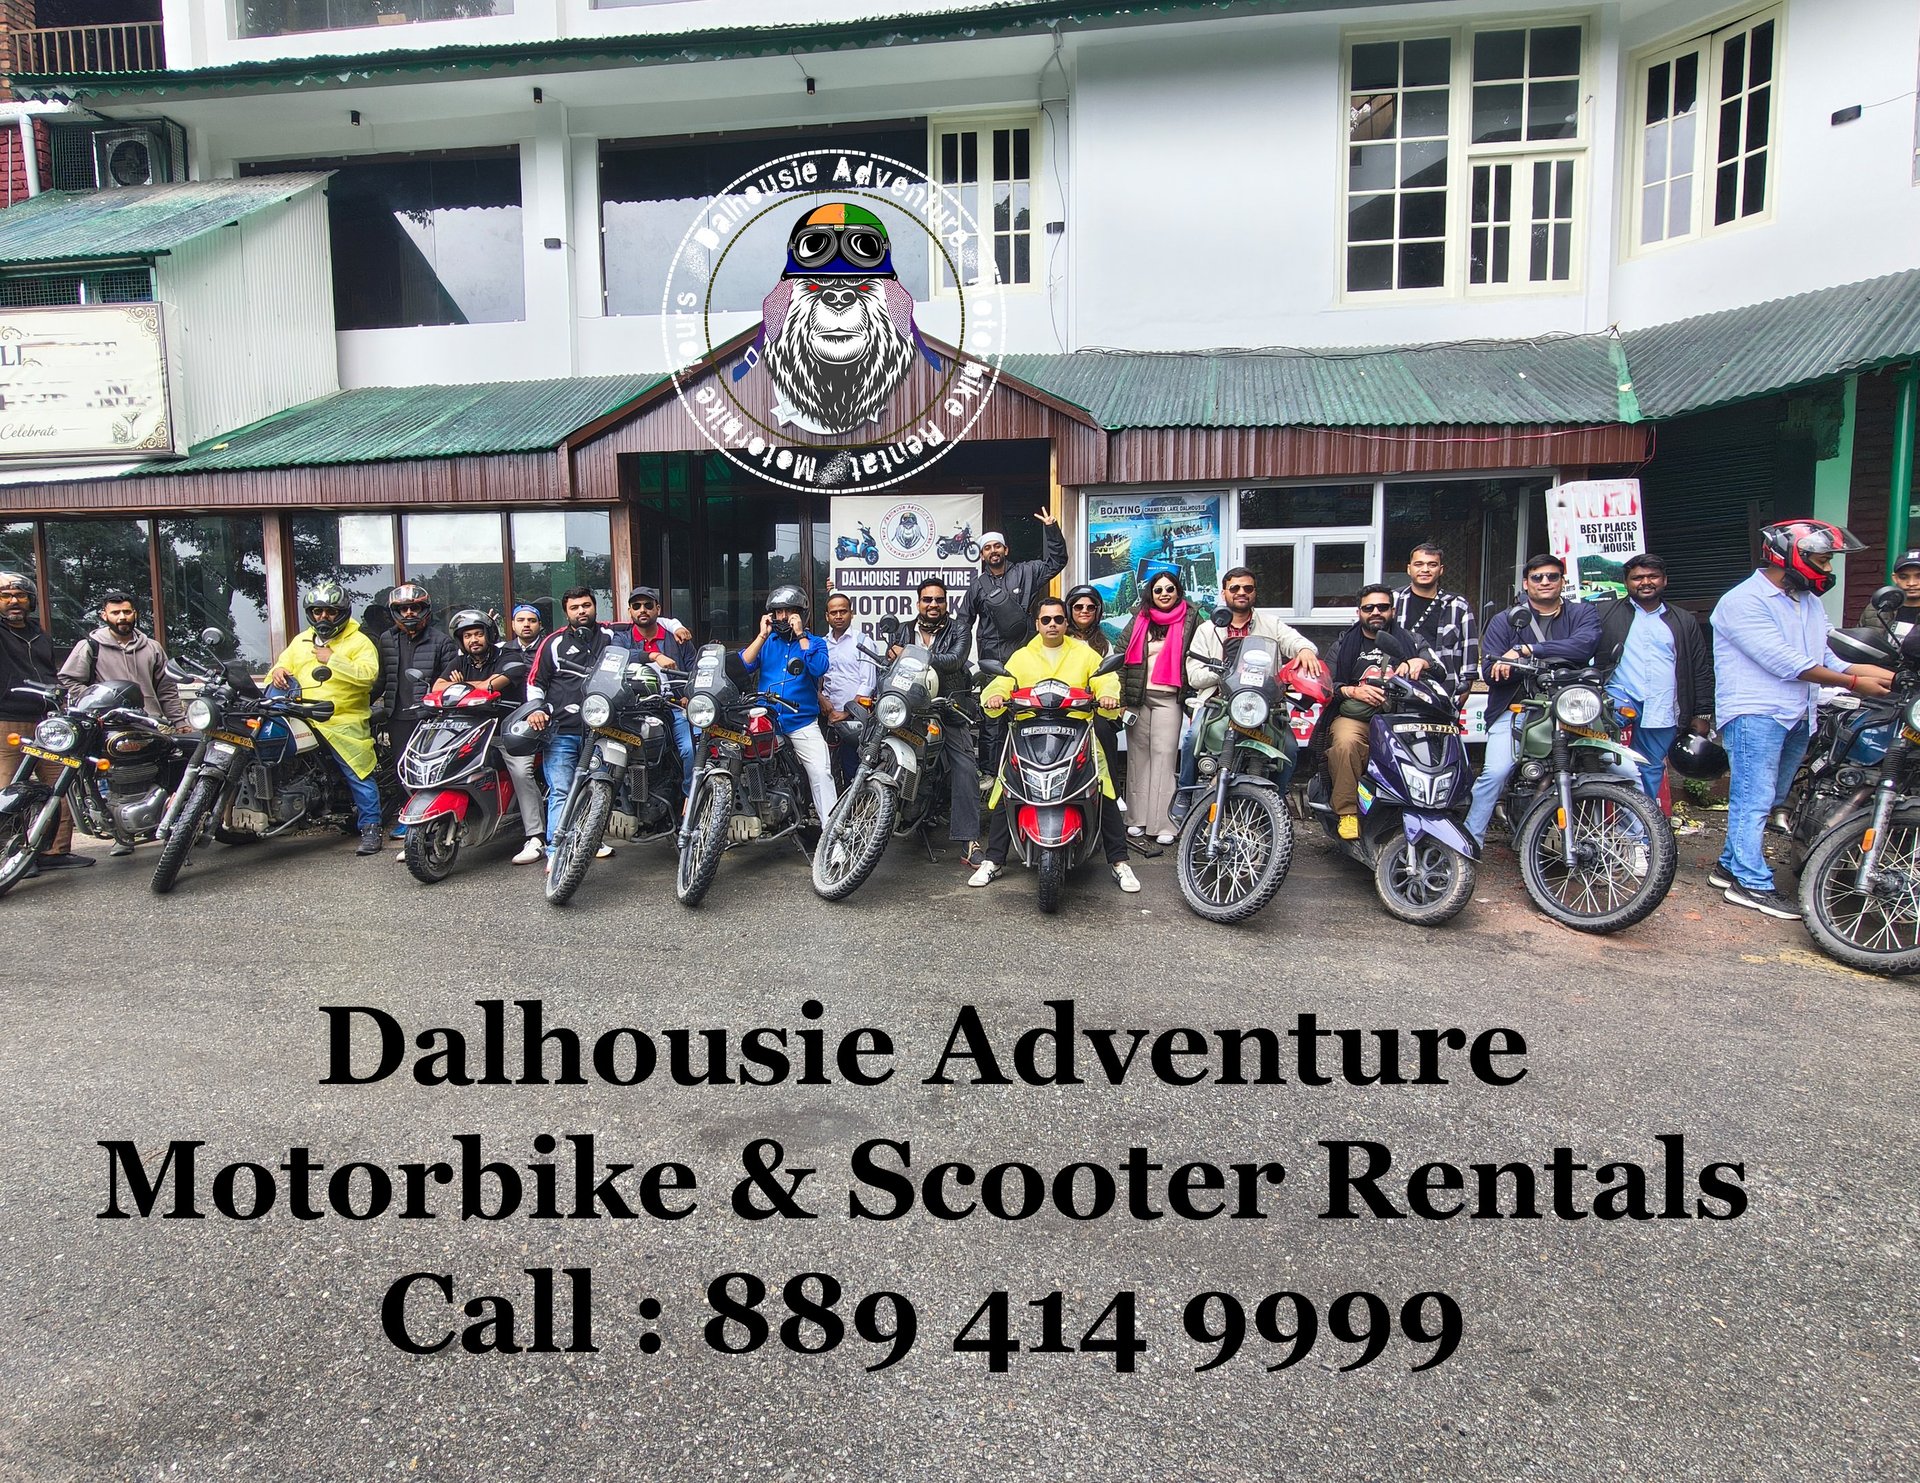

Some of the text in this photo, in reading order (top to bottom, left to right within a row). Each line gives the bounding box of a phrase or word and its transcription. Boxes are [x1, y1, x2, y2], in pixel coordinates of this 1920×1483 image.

[0, 423, 58, 440] Celebrate
[1100, 505, 1141, 515] BOATING
[1179, 504, 1206, 512] DALHOUSIE
[1580, 521, 1637, 534] BEST PLACES
[1585, 531, 1634, 543] TO VISIT IN
[842, 570, 900, 587] DALHOUSIE
[240, 737, 252, 746] 505
